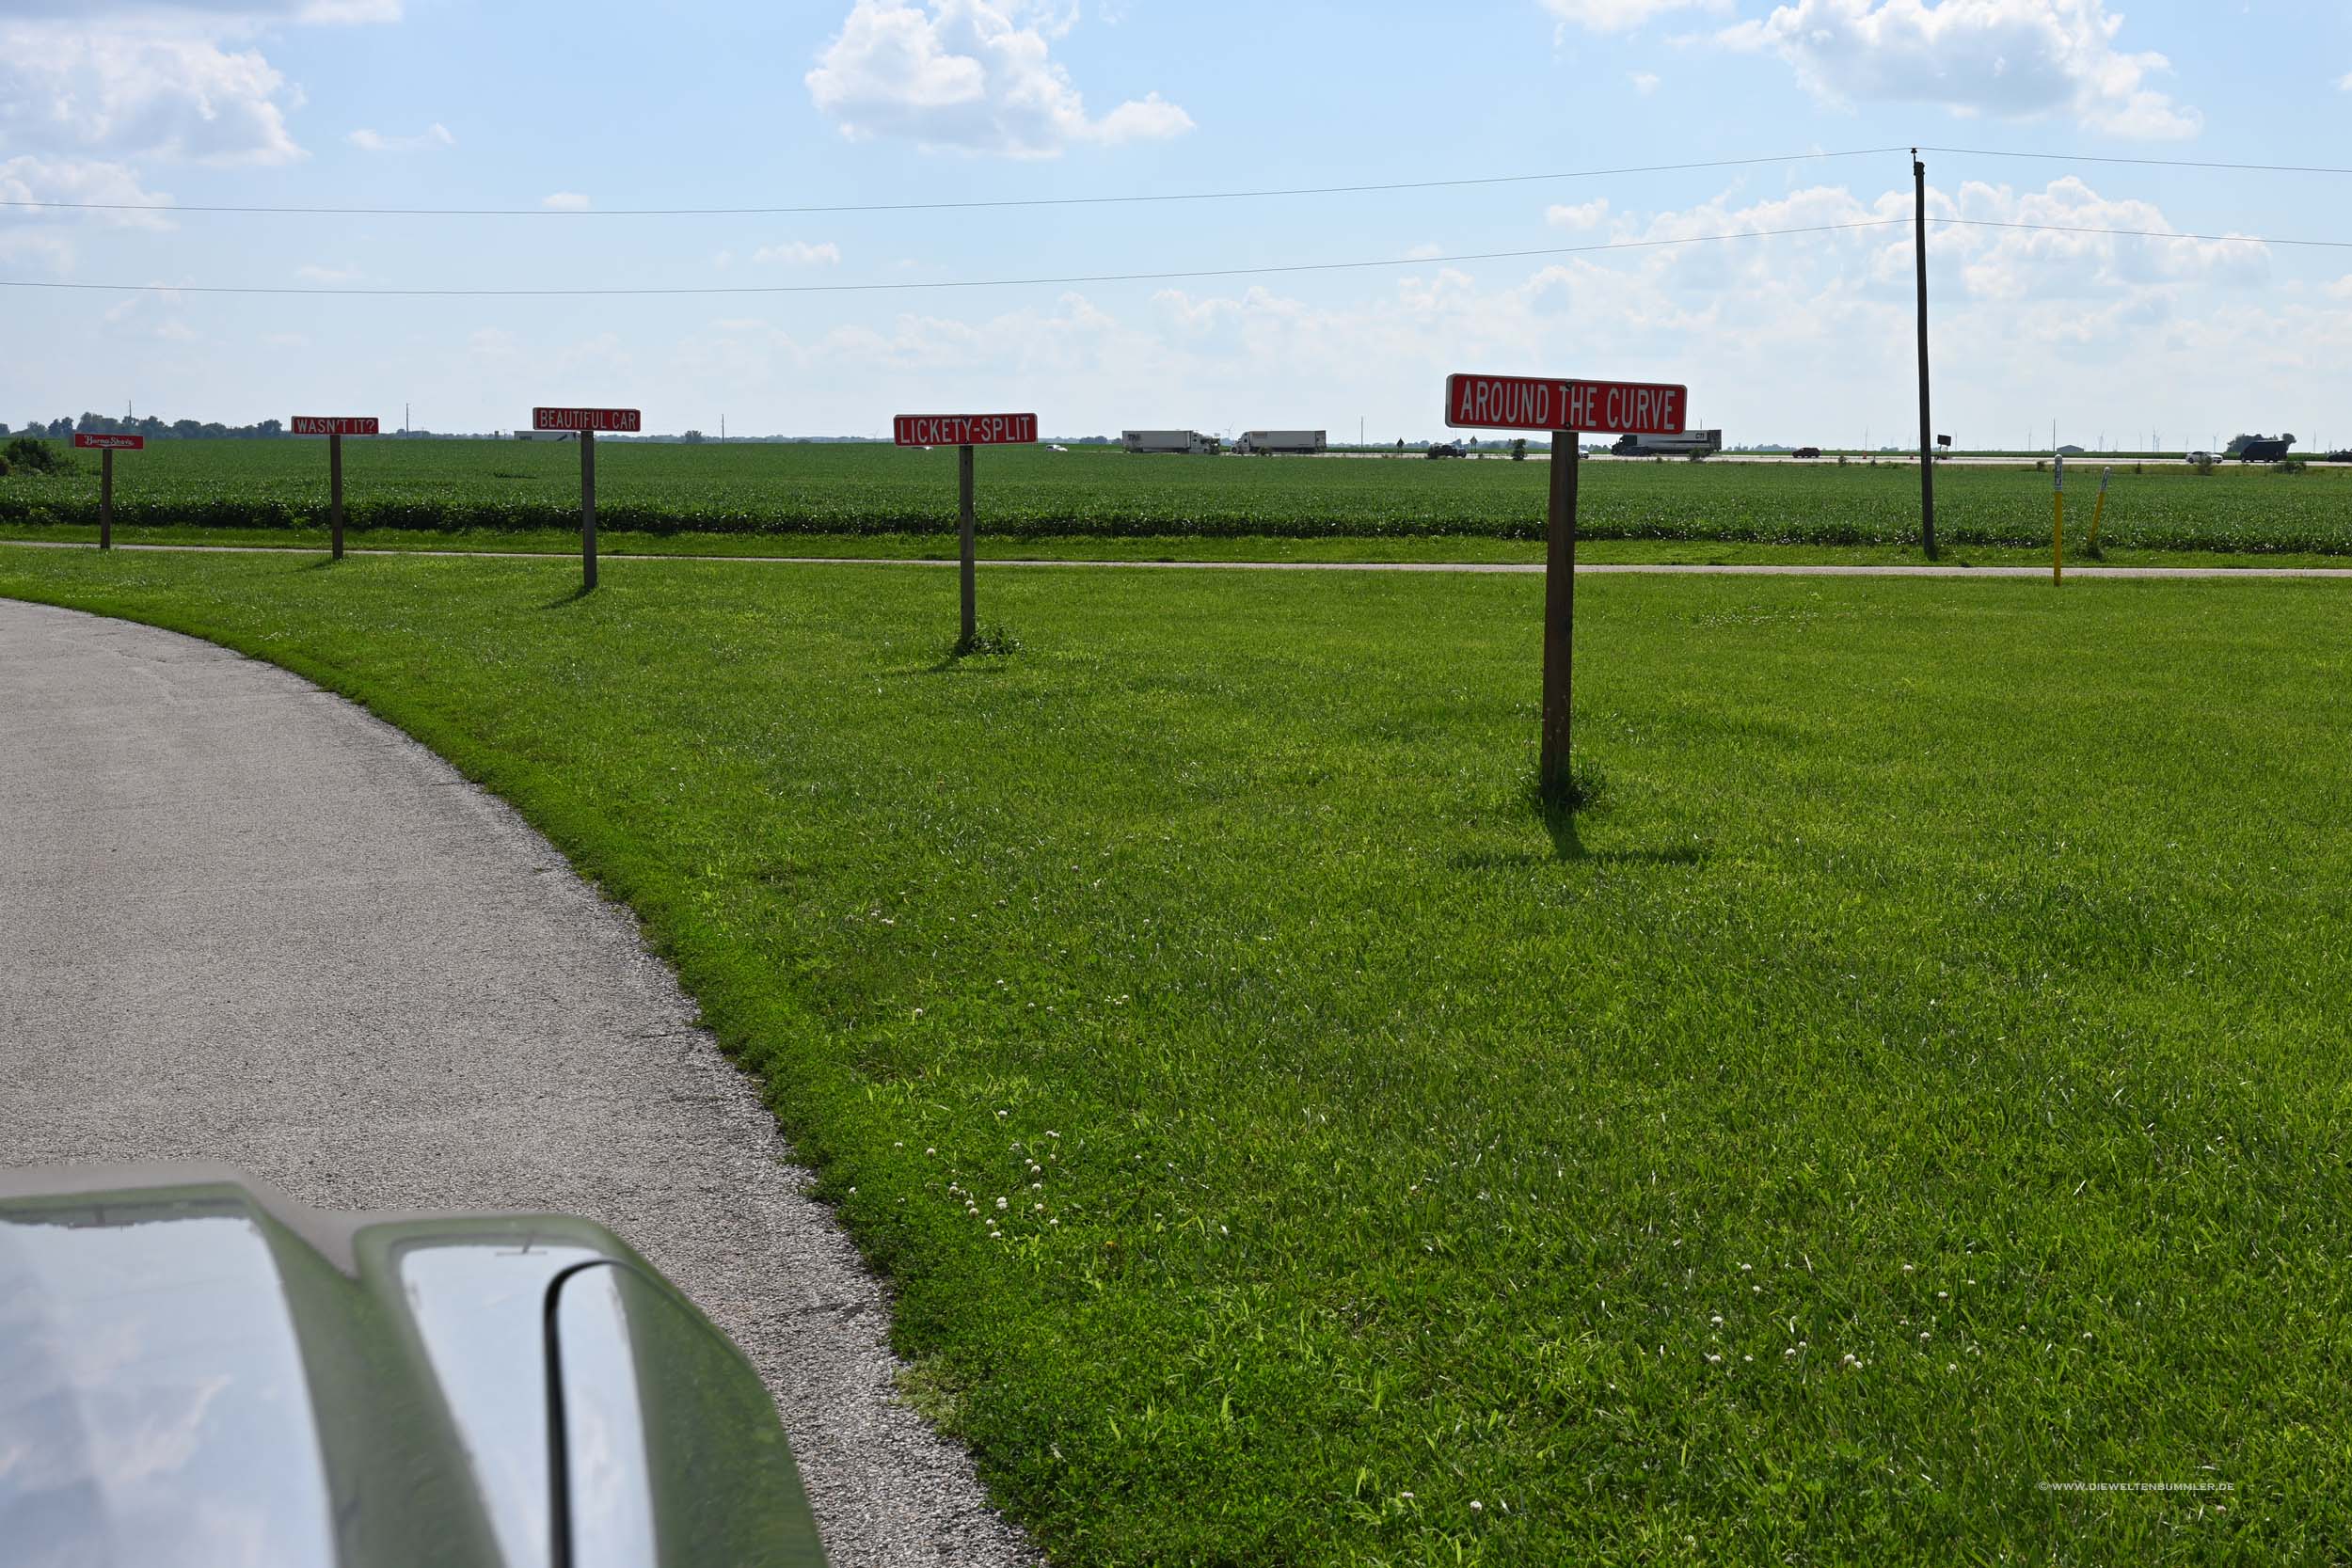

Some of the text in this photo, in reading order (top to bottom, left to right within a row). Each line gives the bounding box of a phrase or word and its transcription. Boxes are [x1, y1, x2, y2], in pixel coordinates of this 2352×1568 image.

[1460, 380, 1676, 429] AROUND THE CURVE
[296, 419, 375, 433] WASN'T IT?
[541, 409, 636, 429] BEAUTIFUL CAR
[899, 417, 1029, 443] LICKETY-SPLIT
